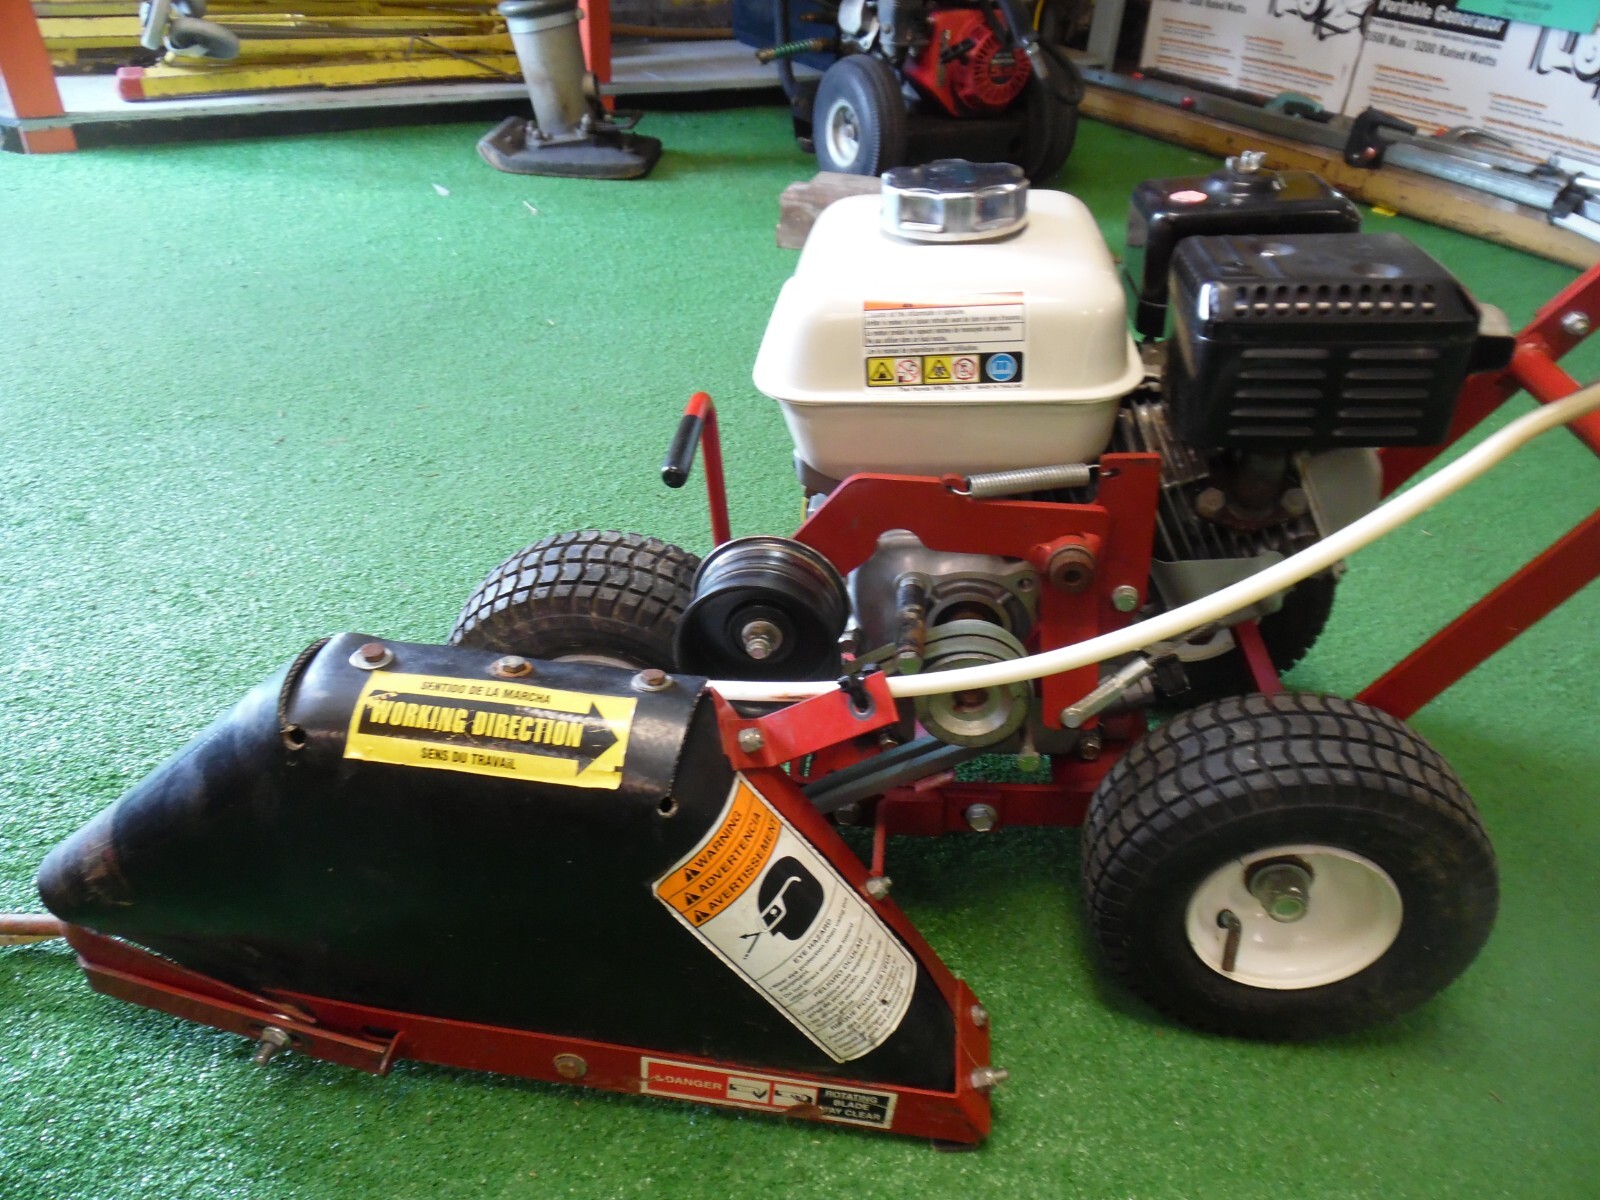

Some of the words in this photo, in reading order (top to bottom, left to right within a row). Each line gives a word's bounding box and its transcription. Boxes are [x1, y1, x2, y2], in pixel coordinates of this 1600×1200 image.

[1377, 0, 1433, 20] Portable
[1434, 4, 1505, 33] Generator
[1439, 45, 1467, 60] Rated
[1469, 51, 1497, 67] Watts
[420, 681, 465, 695] SENTIDO
[469, 686, 484, 695] DE
[485, 687, 500, 698] LA
[502, 689, 551, 704] MARCHA
[368, 699, 467, 733] WORKING
[472, 711, 585, 748] DIRECTION
[420, 747, 447, 762] SENS
[452, 751, 468, 763] DU
[471, 753, 516, 770] TRAVAIL
[693, 809, 742, 866] WARNING
[699, 812, 760, 892] ADVERTENCIA
[709, 818, 776, 911] AVERTISSEMENT
[792, 947, 809, 964] EYE
[806, 917, 832, 950] HAZARD
[813, 968, 843, 997] PELIGRO
[665, 1076, 722, 1091] DANGER
[825, 1090, 878, 1104] ROTATING
[833, 1099, 870, 1111] BLADE
[844, 1109, 881, 1120] CLEAR
